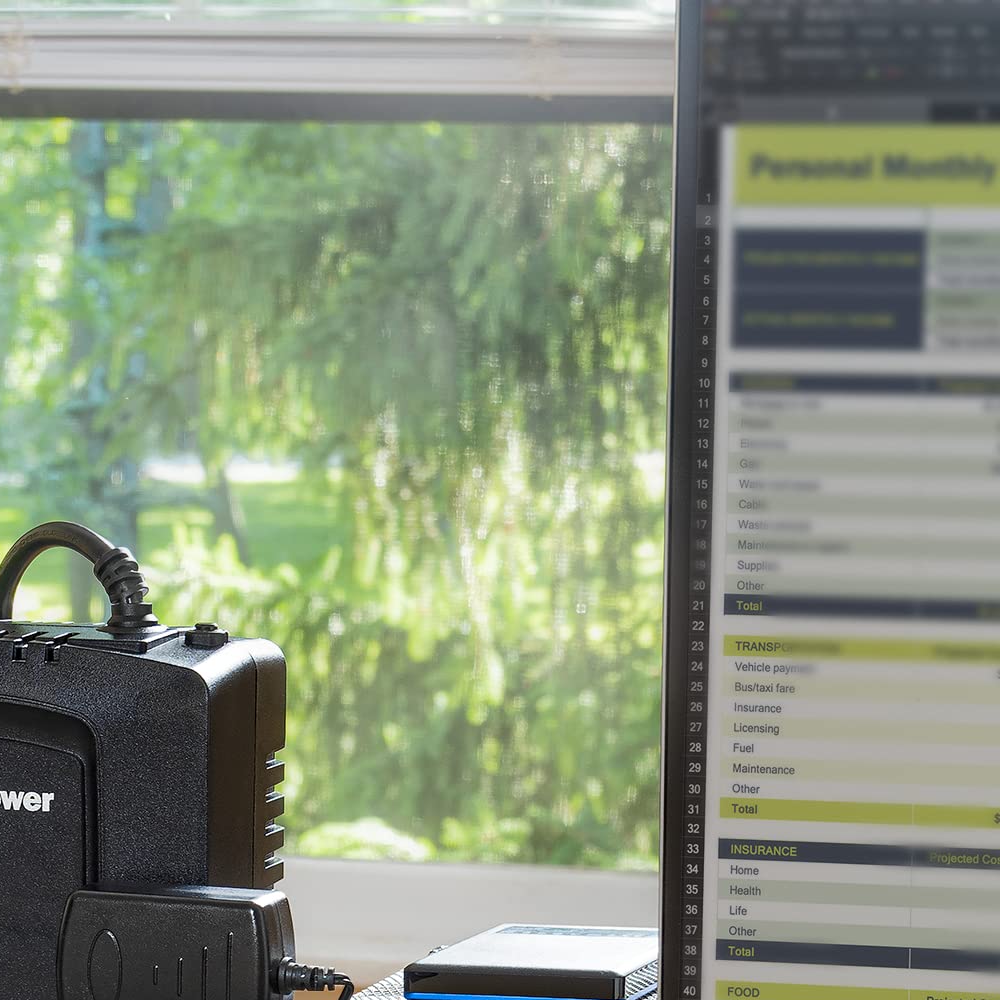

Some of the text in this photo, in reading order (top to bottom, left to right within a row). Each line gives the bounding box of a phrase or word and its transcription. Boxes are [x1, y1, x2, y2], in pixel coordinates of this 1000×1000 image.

[706, 193, 711, 202] 1
[704, 216, 711, 225] 2
[704, 236, 711, 245] 3
[703, 255, 710, 264] 4
[703, 275, 710, 285] 5
[703, 296, 710, 306] 6
[702, 316, 709, 324] 7
[702, 336, 708, 345] 8
[701, 358, 708, 368] 9
[698, 378, 710, 388] 10
[698, 399, 709, 408] 11
[697, 419, 709, 429] 12
[697, 439, 708, 449] 13
[696, 459, 708, 469] 14
[696, 480, 708, 489] 15
[696, 500, 707, 509] 16
[695, 520, 707, 529] 17
[694, 580, 706, 590] 20
[736, 581, 764, 591] Other
[693, 601, 704, 611] 21
[736, 601, 762, 611] Total
[692, 621, 705, 631] 22
[692, 641, 704, 651] 23
[691, 662, 703, 671] 24
[735, 662, 771, 673] Vehicle
[691, 682, 703, 692] 25
[735, 683, 795, 693] Bus/taxi fare
[690, 702, 702, 712] 26
[734, 703, 781, 713] Insurance
[690, 723, 702, 732] 27
[734, 723, 779, 735] Licensing
[689, 743, 702, 753] 28
[733, 743, 754, 753] Fuel
[689, 763, 701, 773] 29
[733, 764, 795, 775] Maintenance
[688, 784, 701, 794] 30
[732, 784, 760, 794] Other
[688, 805, 699, 814] 31
[732, 804, 758, 815] Total
[687, 824, 699, 833] 32
[687, 844, 699, 853] 33
[730, 845, 797, 856] INSURANCE
[929, 852, 979, 865] Projected
[687, 864, 698, 874] 34
[730, 865, 759, 876] Home
[686, 885, 698, 894] 35
[730, 886, 761, 896] Health
[686, 905, 698, 915] 36
[729, 906, 748, 916] Life
[685, 925, 697, 935] 37
[729, 926, 756, 937] Other
[685, 945, 697, 955] 38
[728, 946, 754, 957] Total
[684, 966, 696, 976] 39
[683, 986, 696, 996] 40
[727, 987, 760, 998] FOOD
